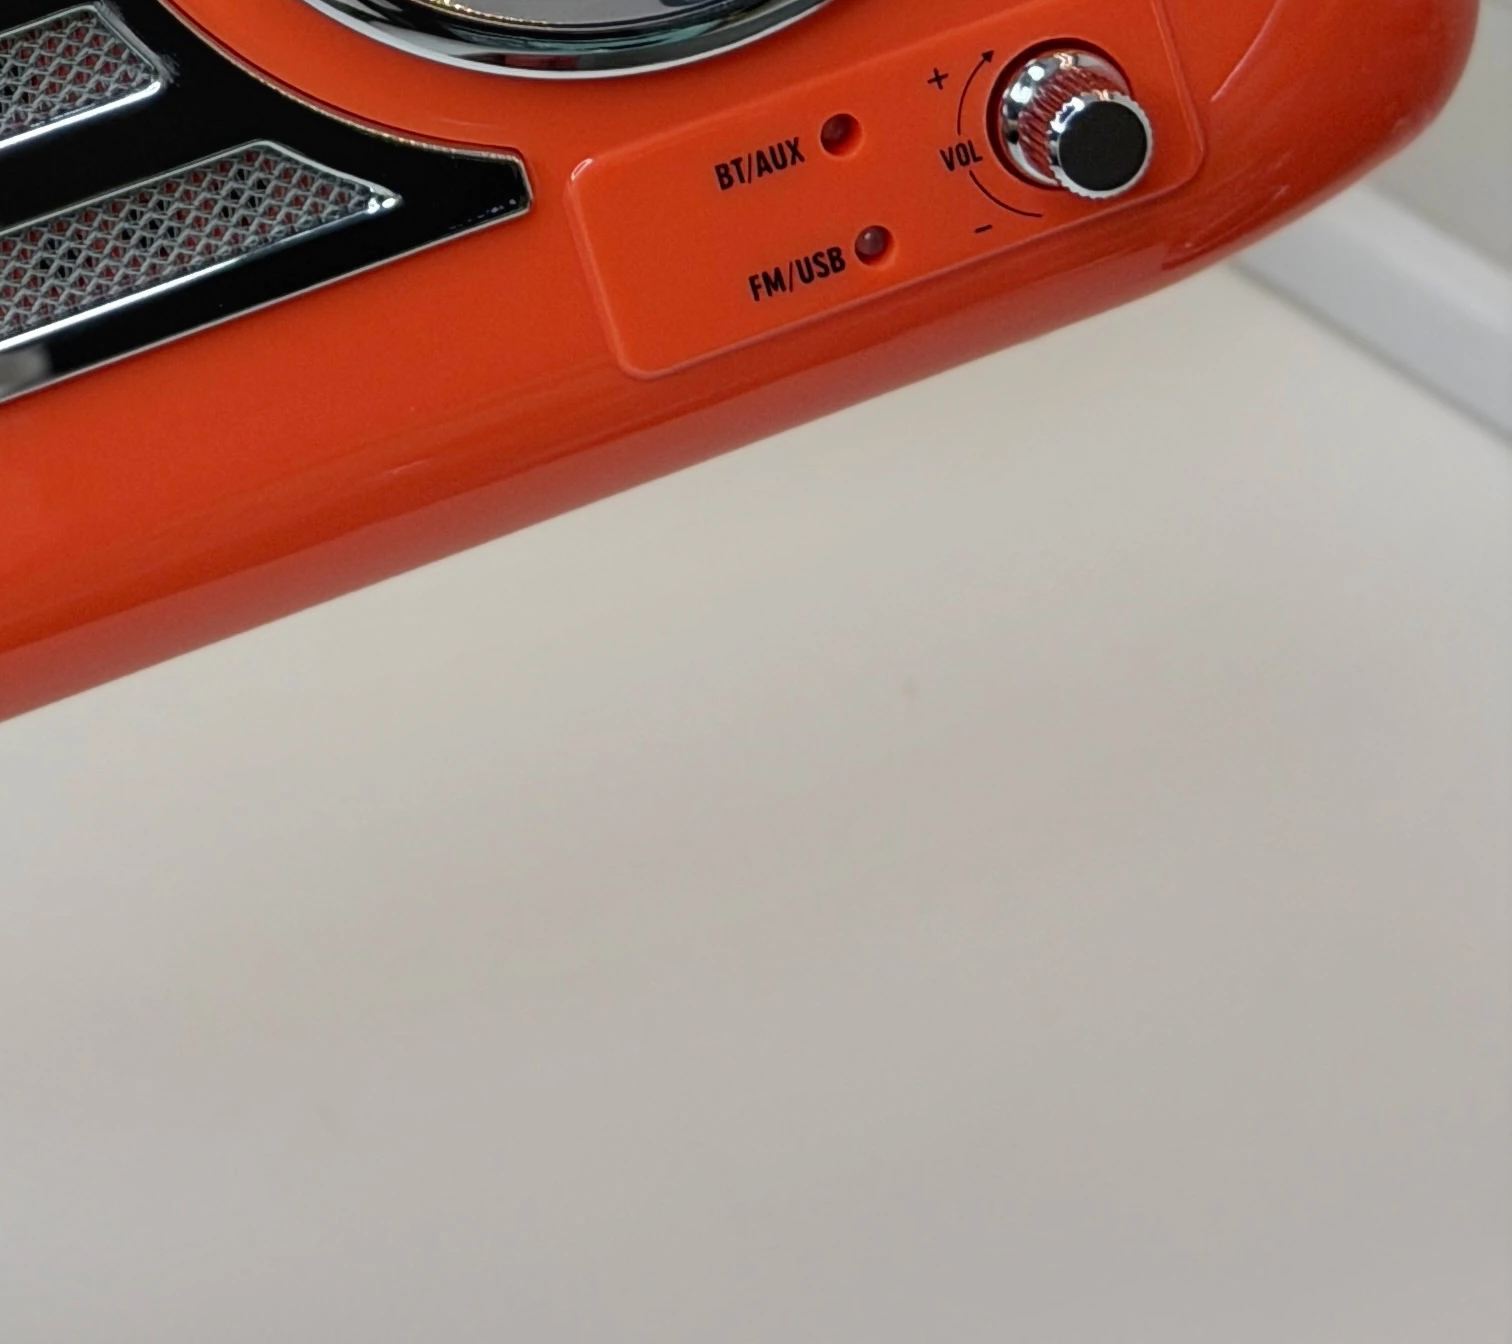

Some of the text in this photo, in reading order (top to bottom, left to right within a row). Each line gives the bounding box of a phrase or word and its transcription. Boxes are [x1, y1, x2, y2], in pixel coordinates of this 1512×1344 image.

[715, 137, 804, 190] BT/AUX
[940, 141, 982, 171] VOL
[749, 247, 845, 301] FM/USB
